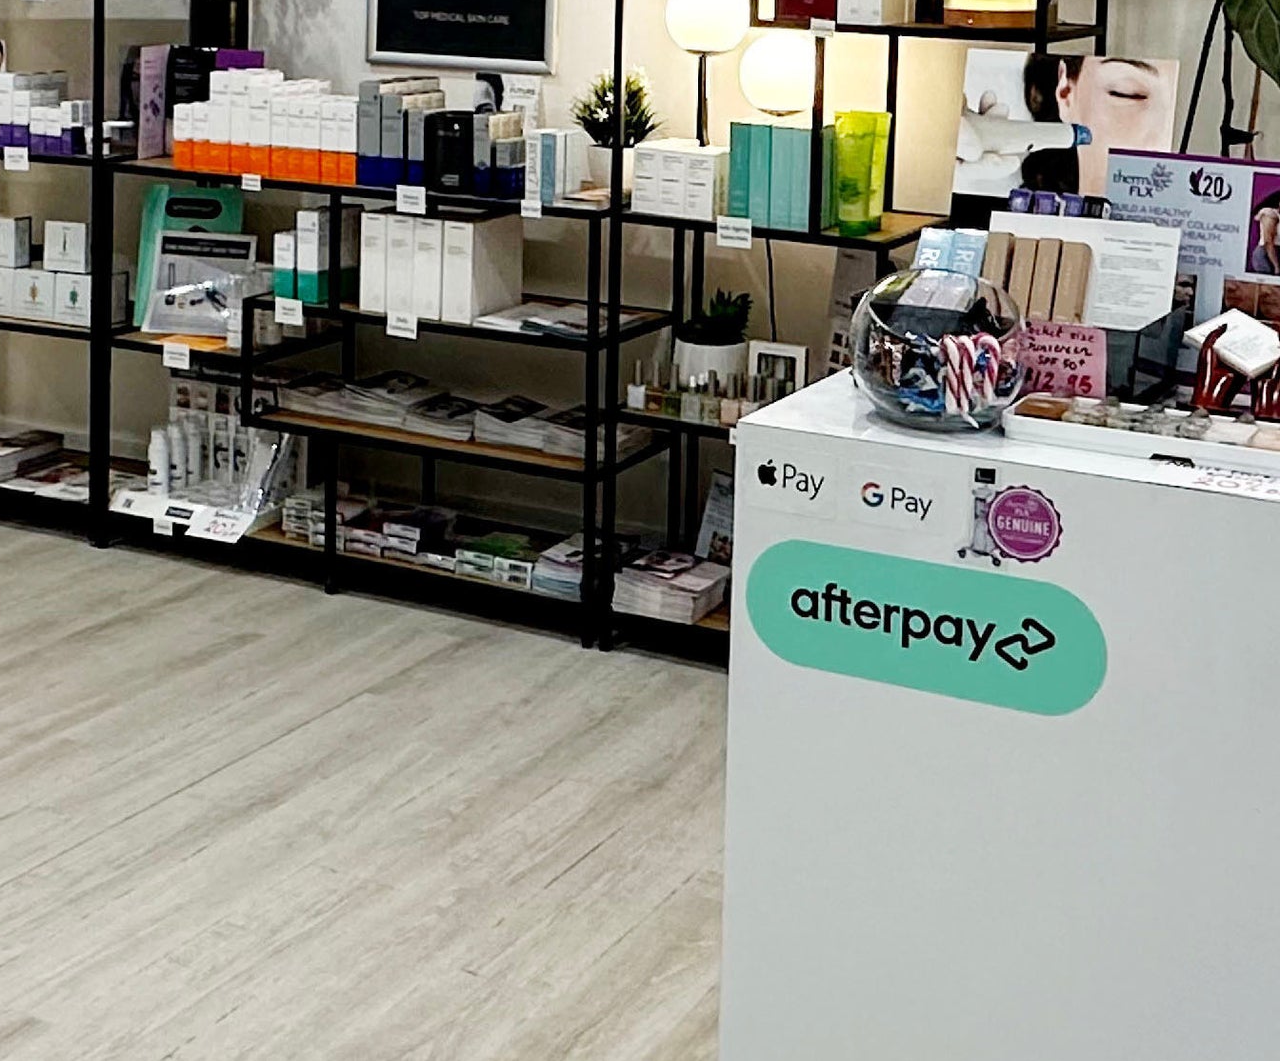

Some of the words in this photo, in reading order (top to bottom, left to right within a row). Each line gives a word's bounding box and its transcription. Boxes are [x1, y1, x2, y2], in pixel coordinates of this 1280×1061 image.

[1129, 185, 1154, 198] FLX
[1202, 174, 1225, 198] 20
[1149, 205, 1193, 219] HEALTHY
[1186, 220, 1240, 234] COLLAGEN
[782, 463, 825, 501] Pay
[860, 481, 885, 508] G
[891, 486, 933, 521] Pay
[996, 515, 1051, 537] GENUINE
[791, 582, 996, 662] afterpay
